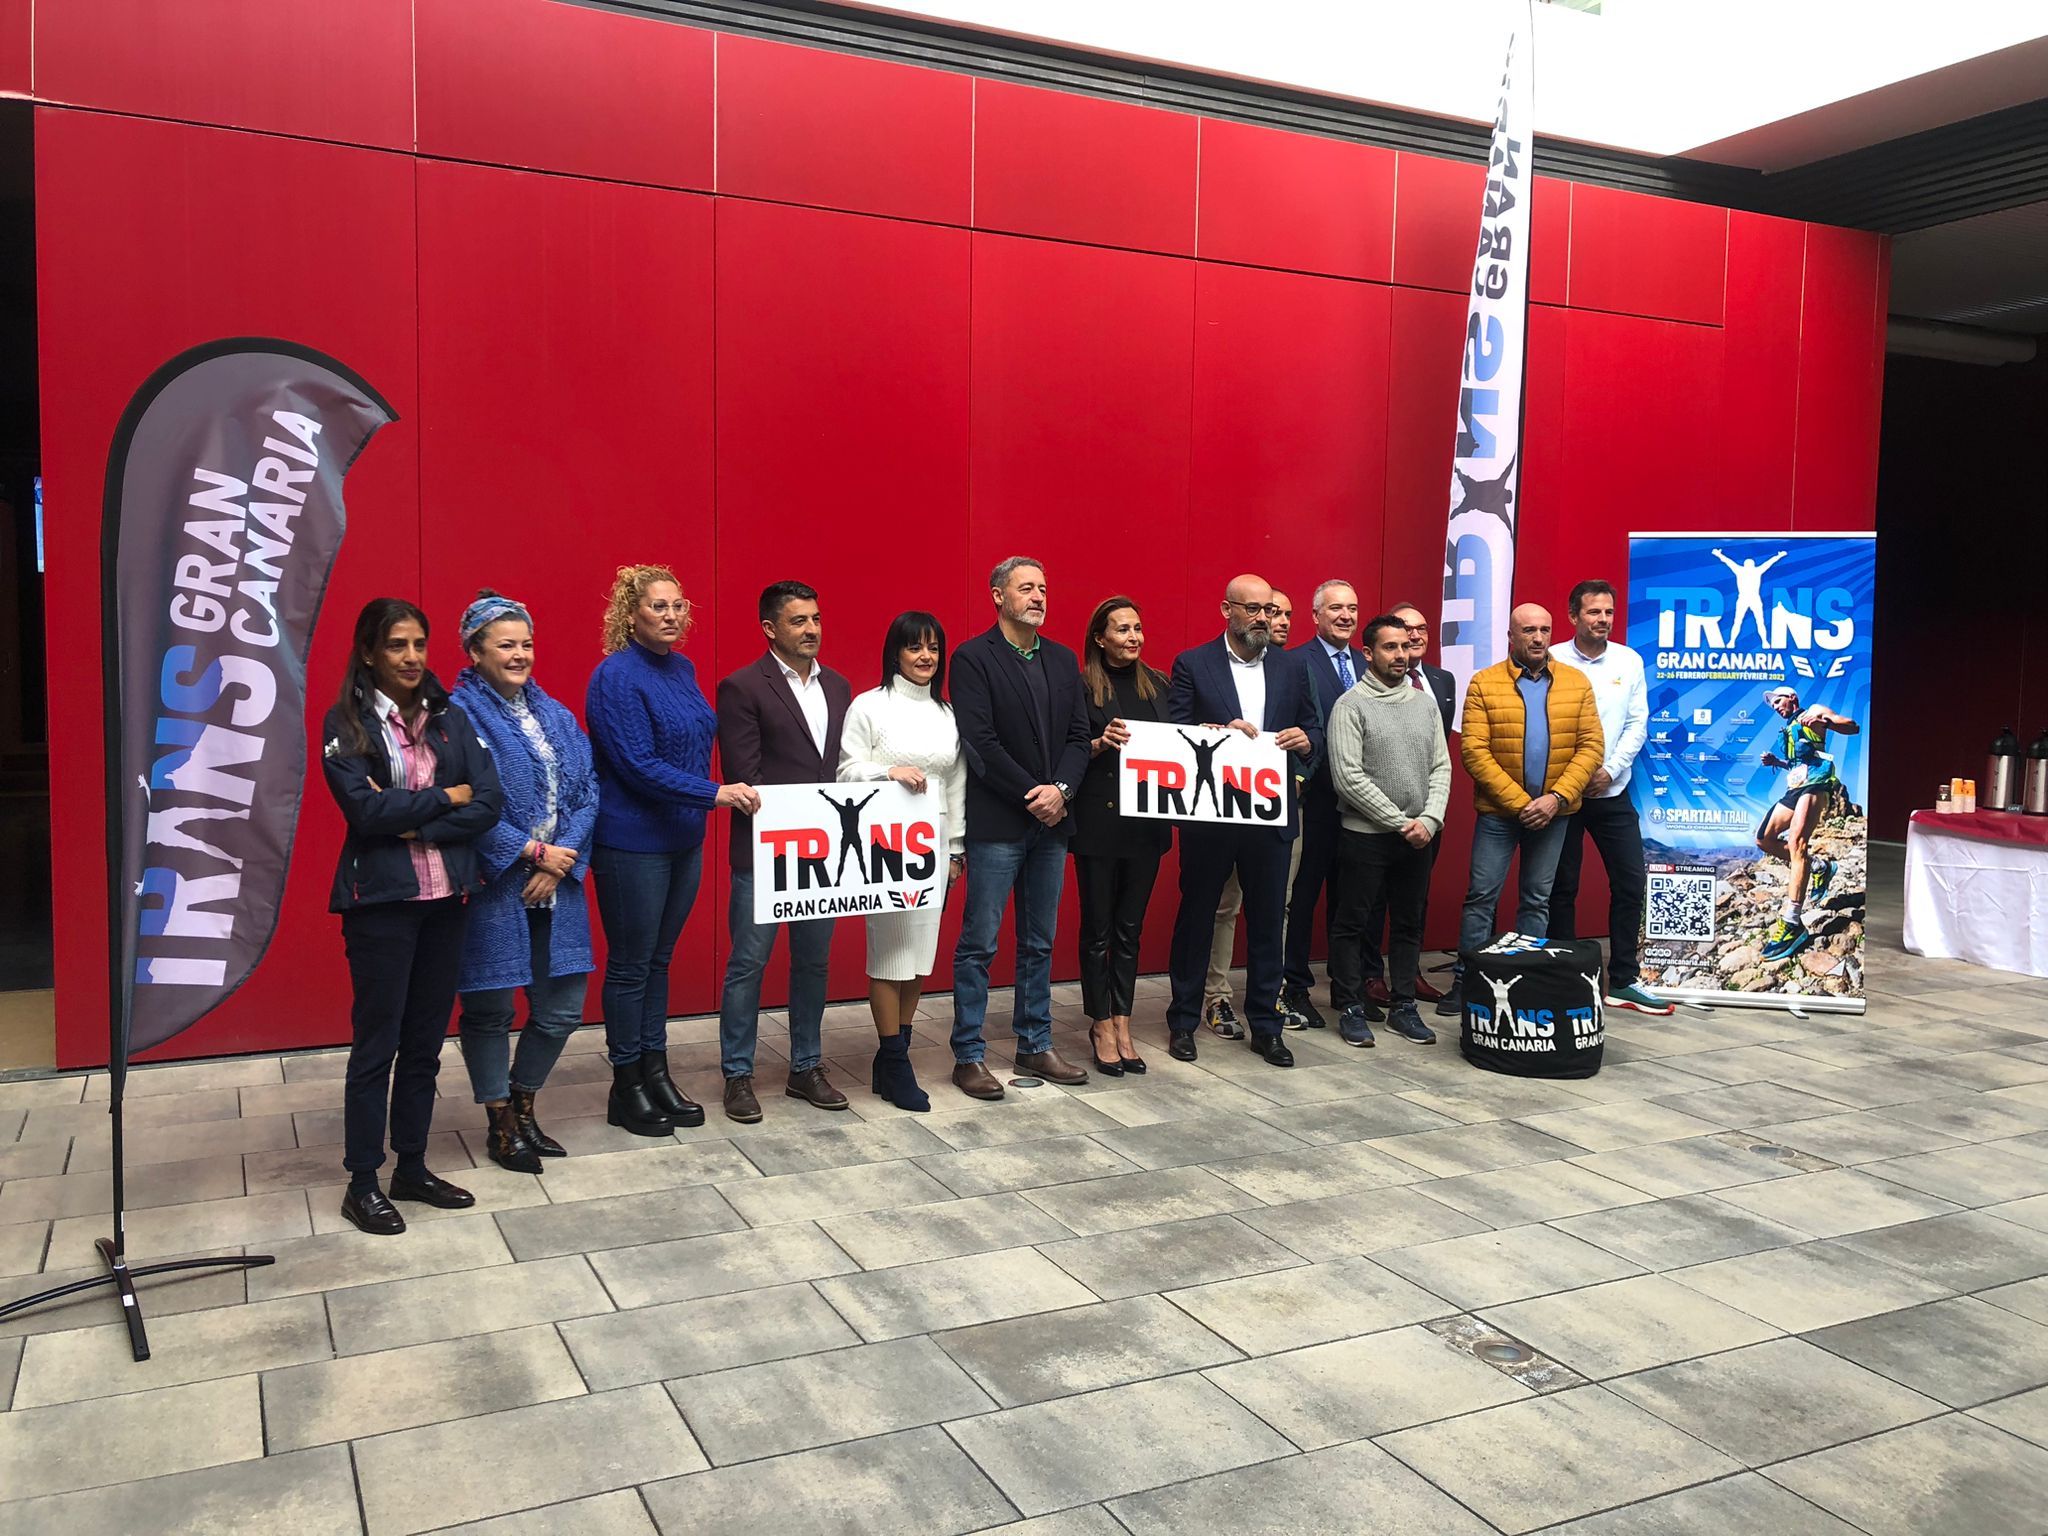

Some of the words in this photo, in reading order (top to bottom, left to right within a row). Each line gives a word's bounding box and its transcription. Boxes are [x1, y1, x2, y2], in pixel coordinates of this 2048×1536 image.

[229, 410, 323, 648] CANARIA
[169, 467, 248, 633] GRAN
[1646, 548, 1854, 650] TRANS
[1656, 651, 1705, 669] GRAN
[1707, 652, 1786, 671] CANARIA
[1656, 671, 1675, 680] 22-26
[1768, 673, 1785, 681] 2023
[1126, 728, 1282, 821] TRANS
[1666, 808, 1722, 823] SPARTAN
[1723, 809, 1748, 825] TRAIL
[760, 788, 936, 892] TRANS
[773, 900, 815, 919] GRAN
[818, 894, 882, 915] CANARIA
[887, 886, 935, 909] SWE
[1472, 1032, 1499, 1050] GRAN
[1501, 1036, 1556, 1052] CANARIA
[1575, 1031, 1599, 1050] GRAN
